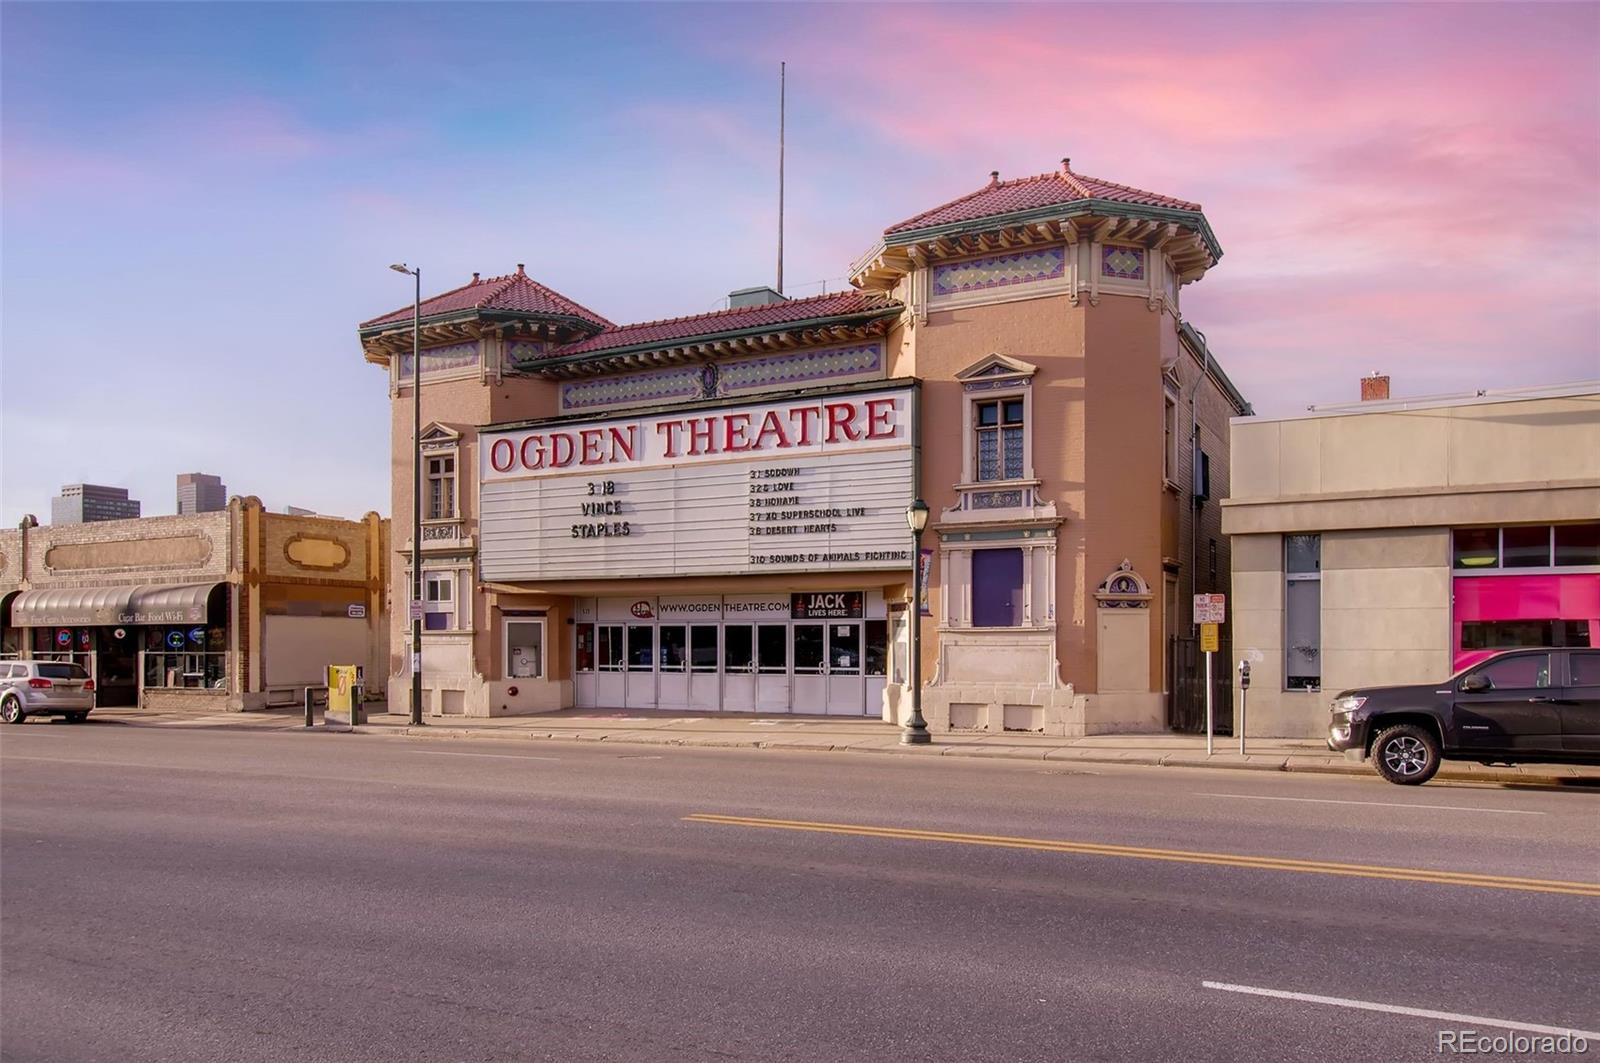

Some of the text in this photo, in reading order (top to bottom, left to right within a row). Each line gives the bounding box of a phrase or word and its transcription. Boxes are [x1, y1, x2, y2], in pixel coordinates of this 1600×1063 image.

[490, 398, 898, 472] OGDEN THEATRE
[773, 482, 794, 492] LOVE
[581, 500, 622, 517] VINCE
[781, 508, 842, 519] SUPERSCHOOL
[846, 507, 865, 517] LIVE
[571, 521, 630, 539] STAPLES
[766, 525, 798, 535] DESERT
[804, 523, 837, 533] HEARTS
[769, 553, 805, 564] SOUNDS
[808, 553, 819, 562] OF
[822, 551, 860, 562] ANIMALS
[865, 550, 907, 561] FIGHTING
[808, 594, 846, 609] JACK
[118, 612, 133, 623] Cigar
[134, 612, 145, 622] Bar
[148, 611, 164, 621] Food
[808, 609, 827, 617] LIVES
